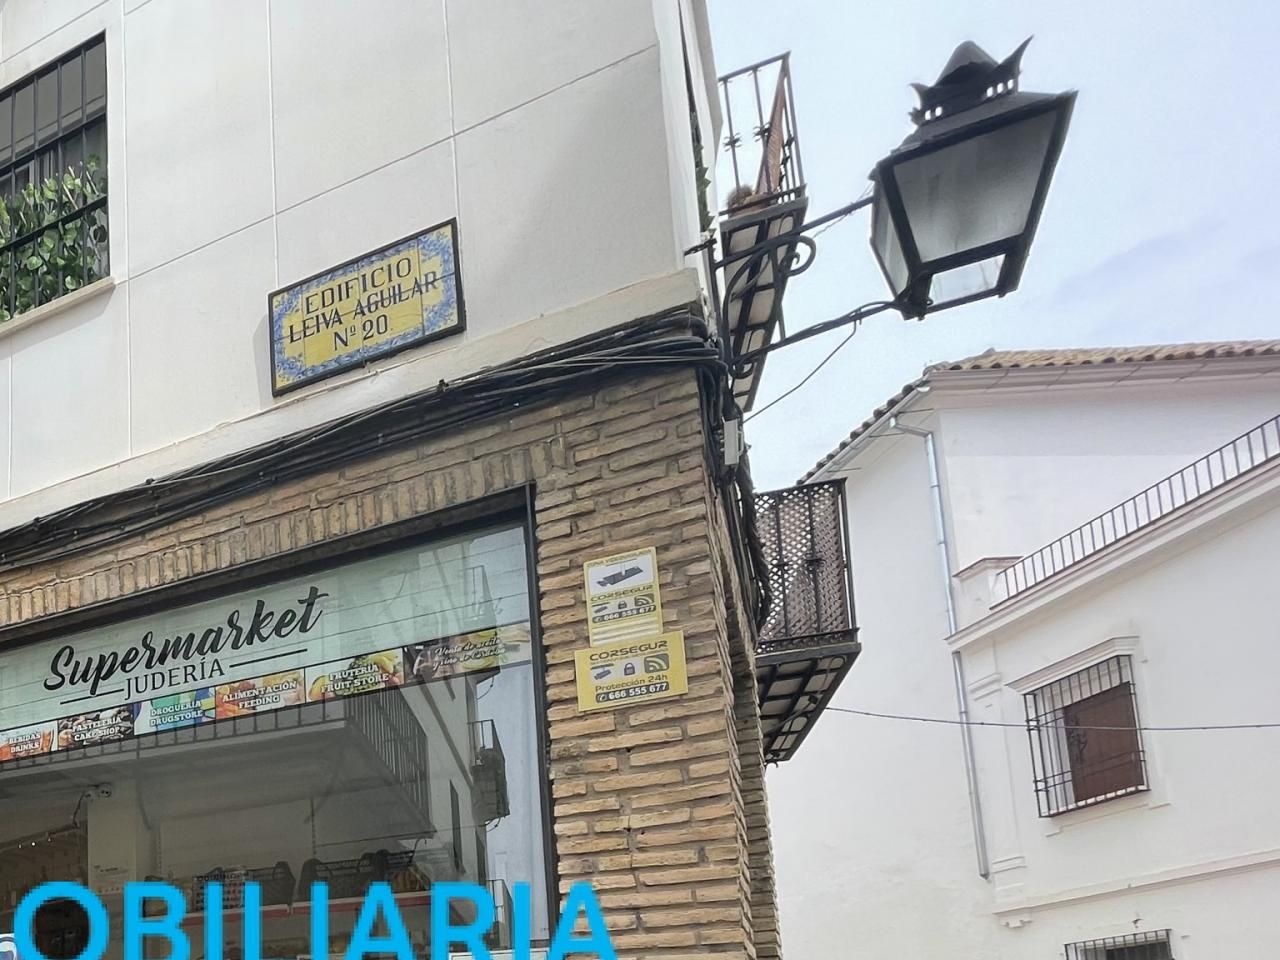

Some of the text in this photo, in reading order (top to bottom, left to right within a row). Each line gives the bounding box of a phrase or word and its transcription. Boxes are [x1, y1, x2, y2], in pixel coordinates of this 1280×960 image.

[306, 257, 413, 314] EDIFICIO
[288, 271, 439, 344] LEIVA AGUILAR
[363, 314, 389, 341] 20
[590, 585, 653, 602] CORSEGUR
[604, 612, 620, 621] 666
[43, 585, 329, 696] Supermarket
[590, 640, 668, 661] CORSEGUR
[124, 657, 225, 700] JUDERÍA
[321, 673, 389, 693] FRUIT STORE
[595, 674, 668, 692] Protección 24h
[222, 680, 297, 702] ALIMENTACIÓN
[609, 690, 627, 700] 666
[629, 686, 647, 696] 555
[649, 682, 667, 692] 677
[238, 695, 281, 710] FEEDING
[149, 710, 203, 727] DRUGSTORE
[9, 733, 41, 744] BEBIDAS
[74, 726, 120, 742] CAKE SHOP
[10, 741, 40, 753] DRINKS
